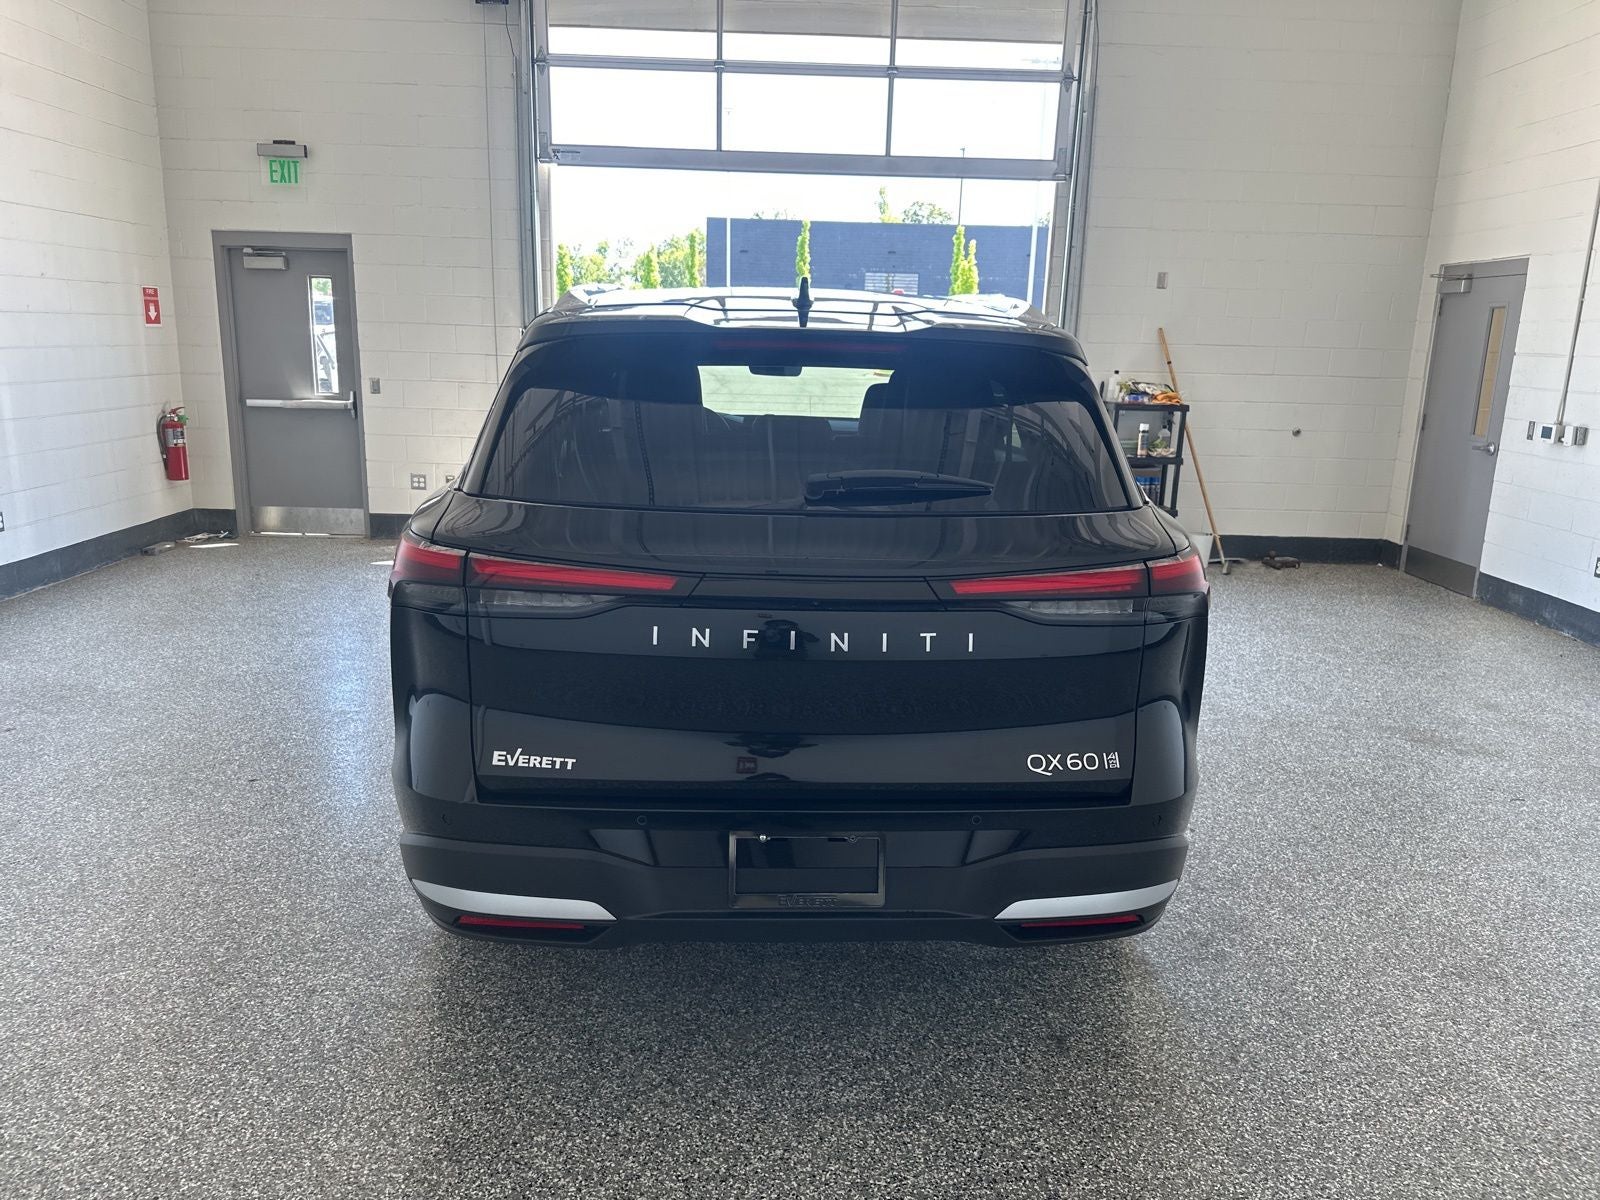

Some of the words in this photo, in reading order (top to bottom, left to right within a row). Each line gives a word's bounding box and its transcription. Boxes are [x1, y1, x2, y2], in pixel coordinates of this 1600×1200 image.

[269, 159, 299, 184] EXIT
[652, 625, 974, 652] INFINITI
[492, 748, 576, 770] EVERETT
[1027, 752, 1099, 776] QX60
